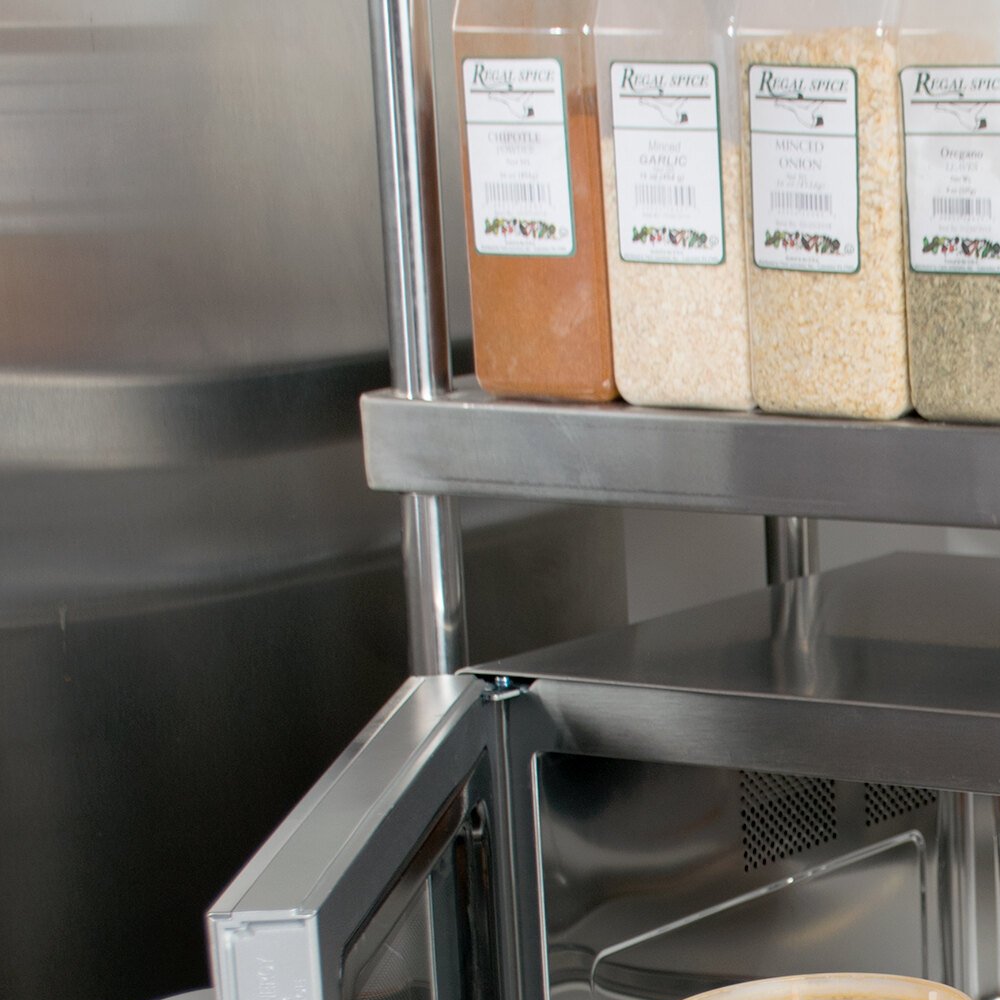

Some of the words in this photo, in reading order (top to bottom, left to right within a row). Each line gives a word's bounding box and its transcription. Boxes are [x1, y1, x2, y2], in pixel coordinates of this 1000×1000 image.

[472, 64, 515, 85] REGAL
[519, 69, 556, 83] SPICE
[621, 66, 665, 89] REGAL
[670, 73, 709, 88] SPICE
[758, 70, 806, 94] REGAL
[810, 78, 849, 93] SPICE
[914, 71, 965, 95] REGAL
[775, 139, 825, 152] MINCED
[940, 147, 984, 159] Oregano
[639, 154, 688, 167] GARLIC
[778, 158, 822, 171] ONION
